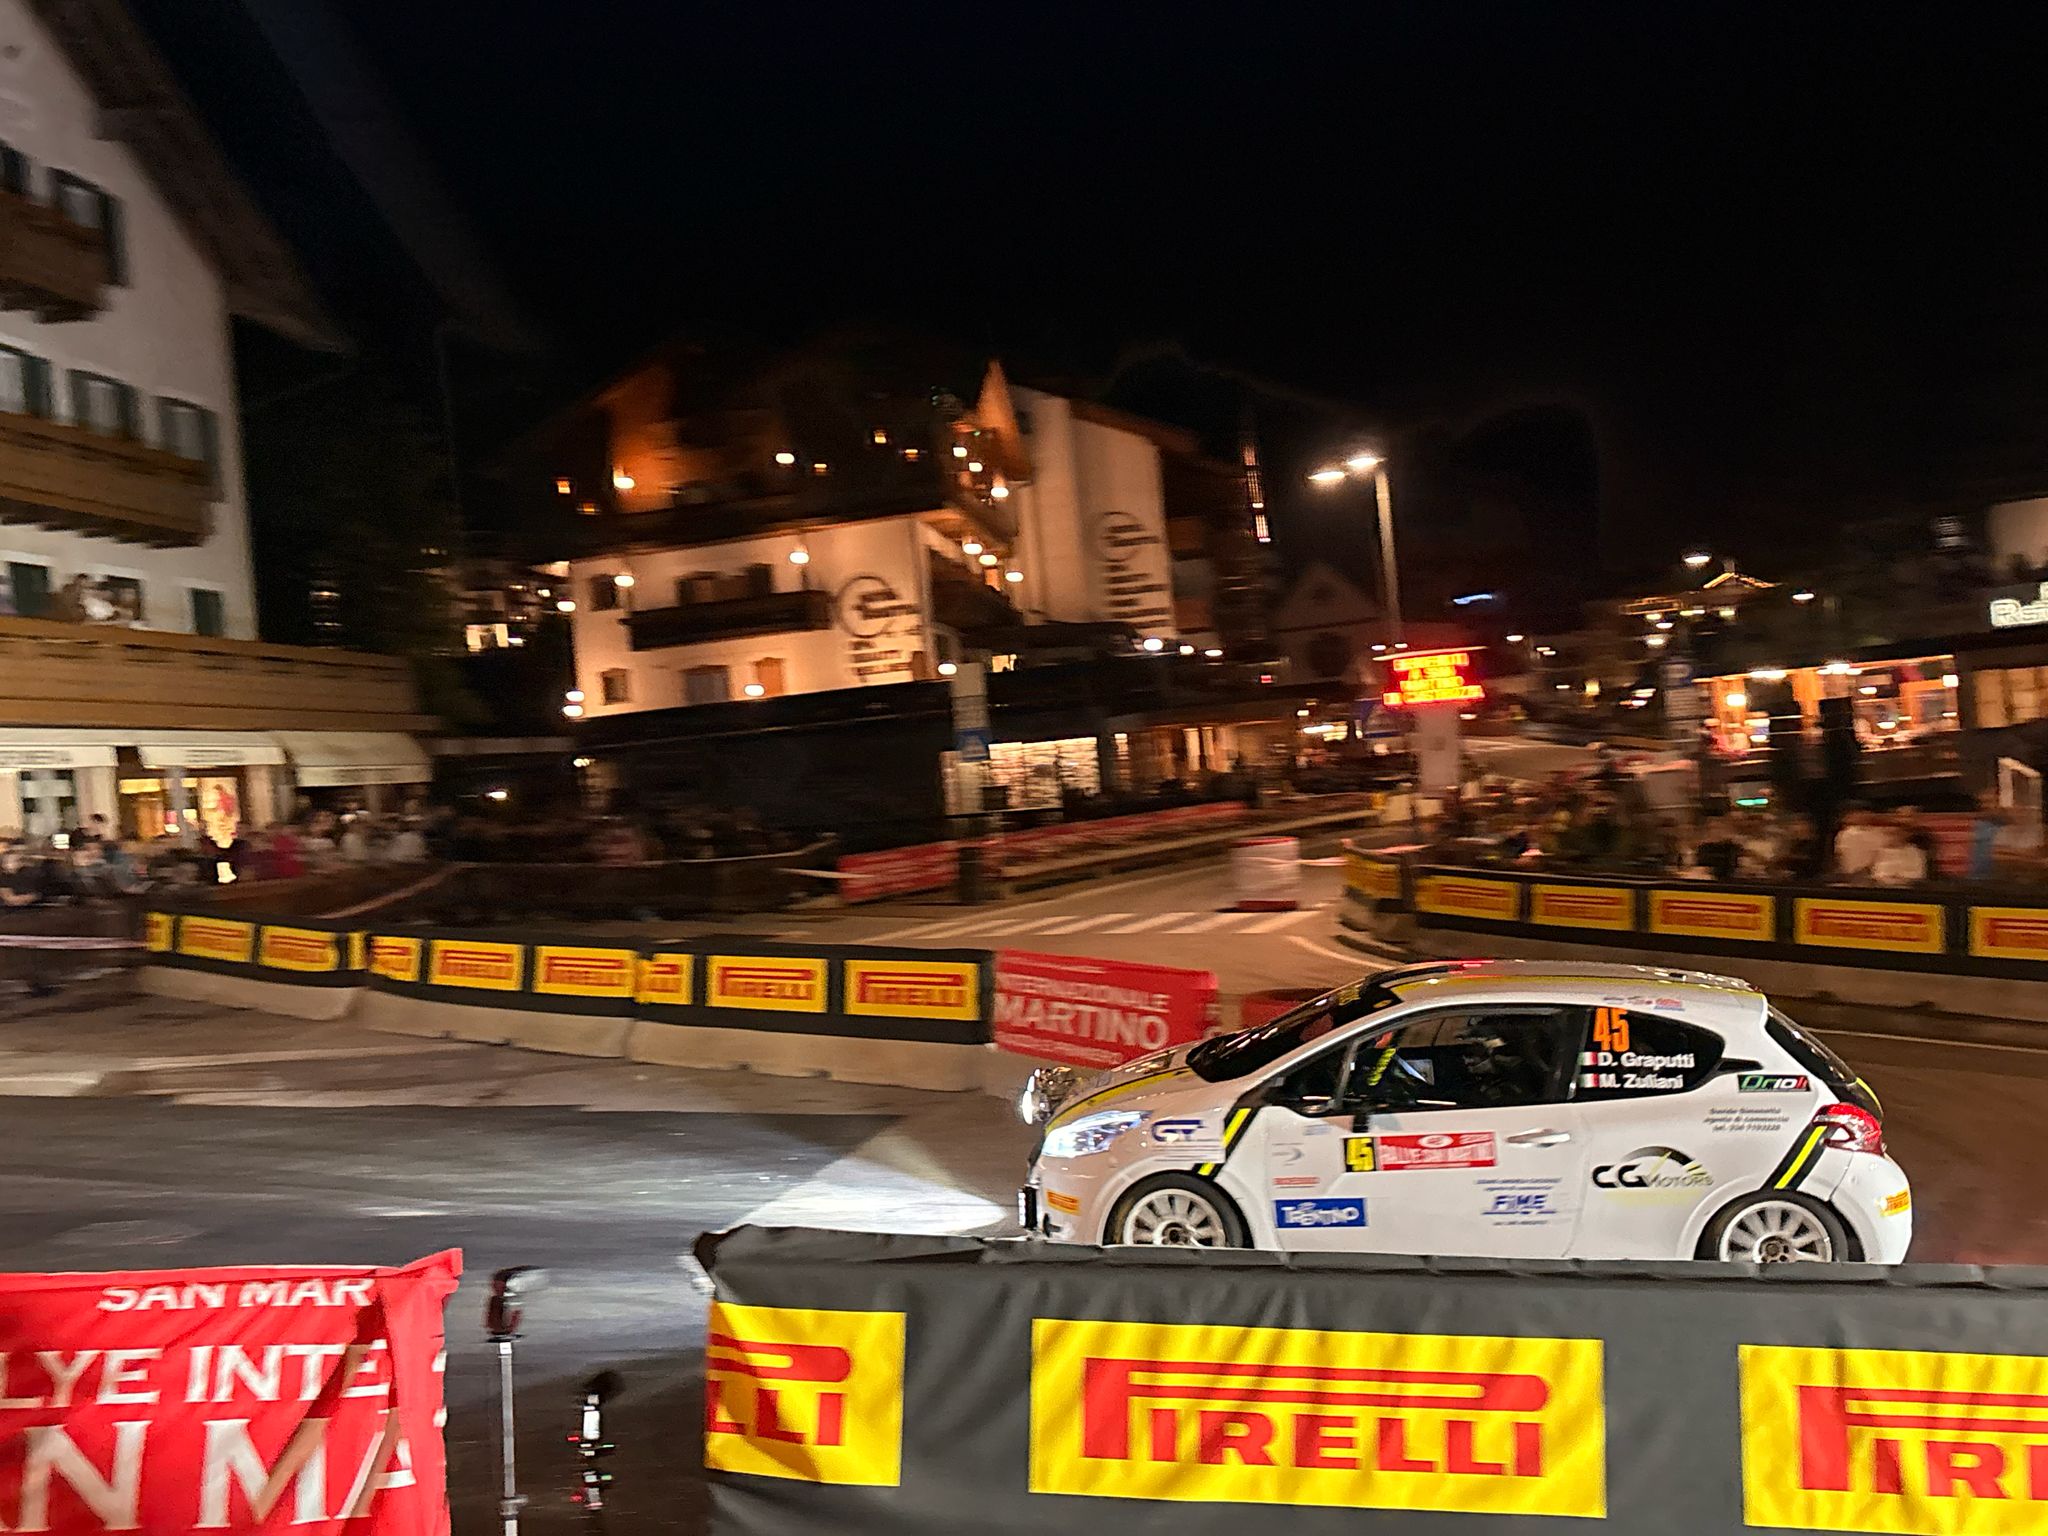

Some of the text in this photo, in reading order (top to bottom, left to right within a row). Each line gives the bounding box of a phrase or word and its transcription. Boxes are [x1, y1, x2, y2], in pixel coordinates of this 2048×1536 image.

[1593, 1007, 1630, 1052] 45
[1597, 1052, 1619, 1067] D.
[1599, 1073, 1621, 1088] M.
[96, 1278, 375, 1312] SAN MAR
[0, 1339, 390, 1409] LYE INTE
[1082, 1357, 1550, 1477] PIRELLI
[0, 1418, 153, 1532] N
